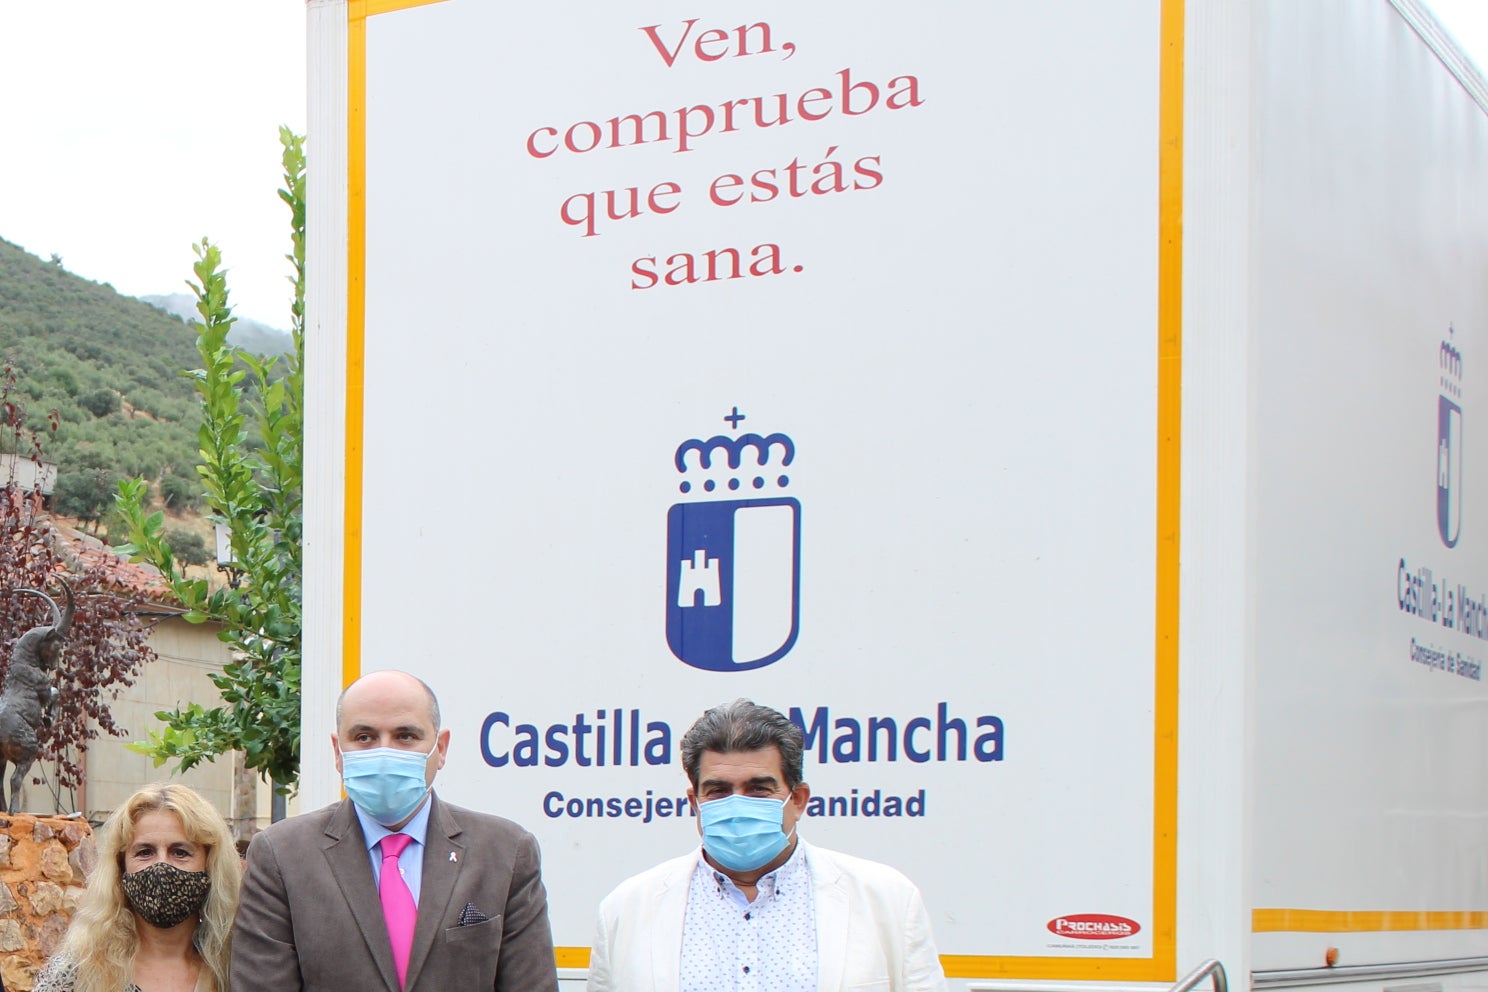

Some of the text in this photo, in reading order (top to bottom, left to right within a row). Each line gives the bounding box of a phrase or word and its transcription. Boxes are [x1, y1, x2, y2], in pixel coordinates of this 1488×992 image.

[639, 18, 797, 68] Ven,
[526, 68, 927, 159] comprueba
[560, 146, 884, 238] que estás
[631, 243, 804, 290] sana.
[1456, 583, 1488, 641] Manch
[480, 702, 1006, 768] Castilla Mancha
[543, 789, 928, 824] Consejer anidad
